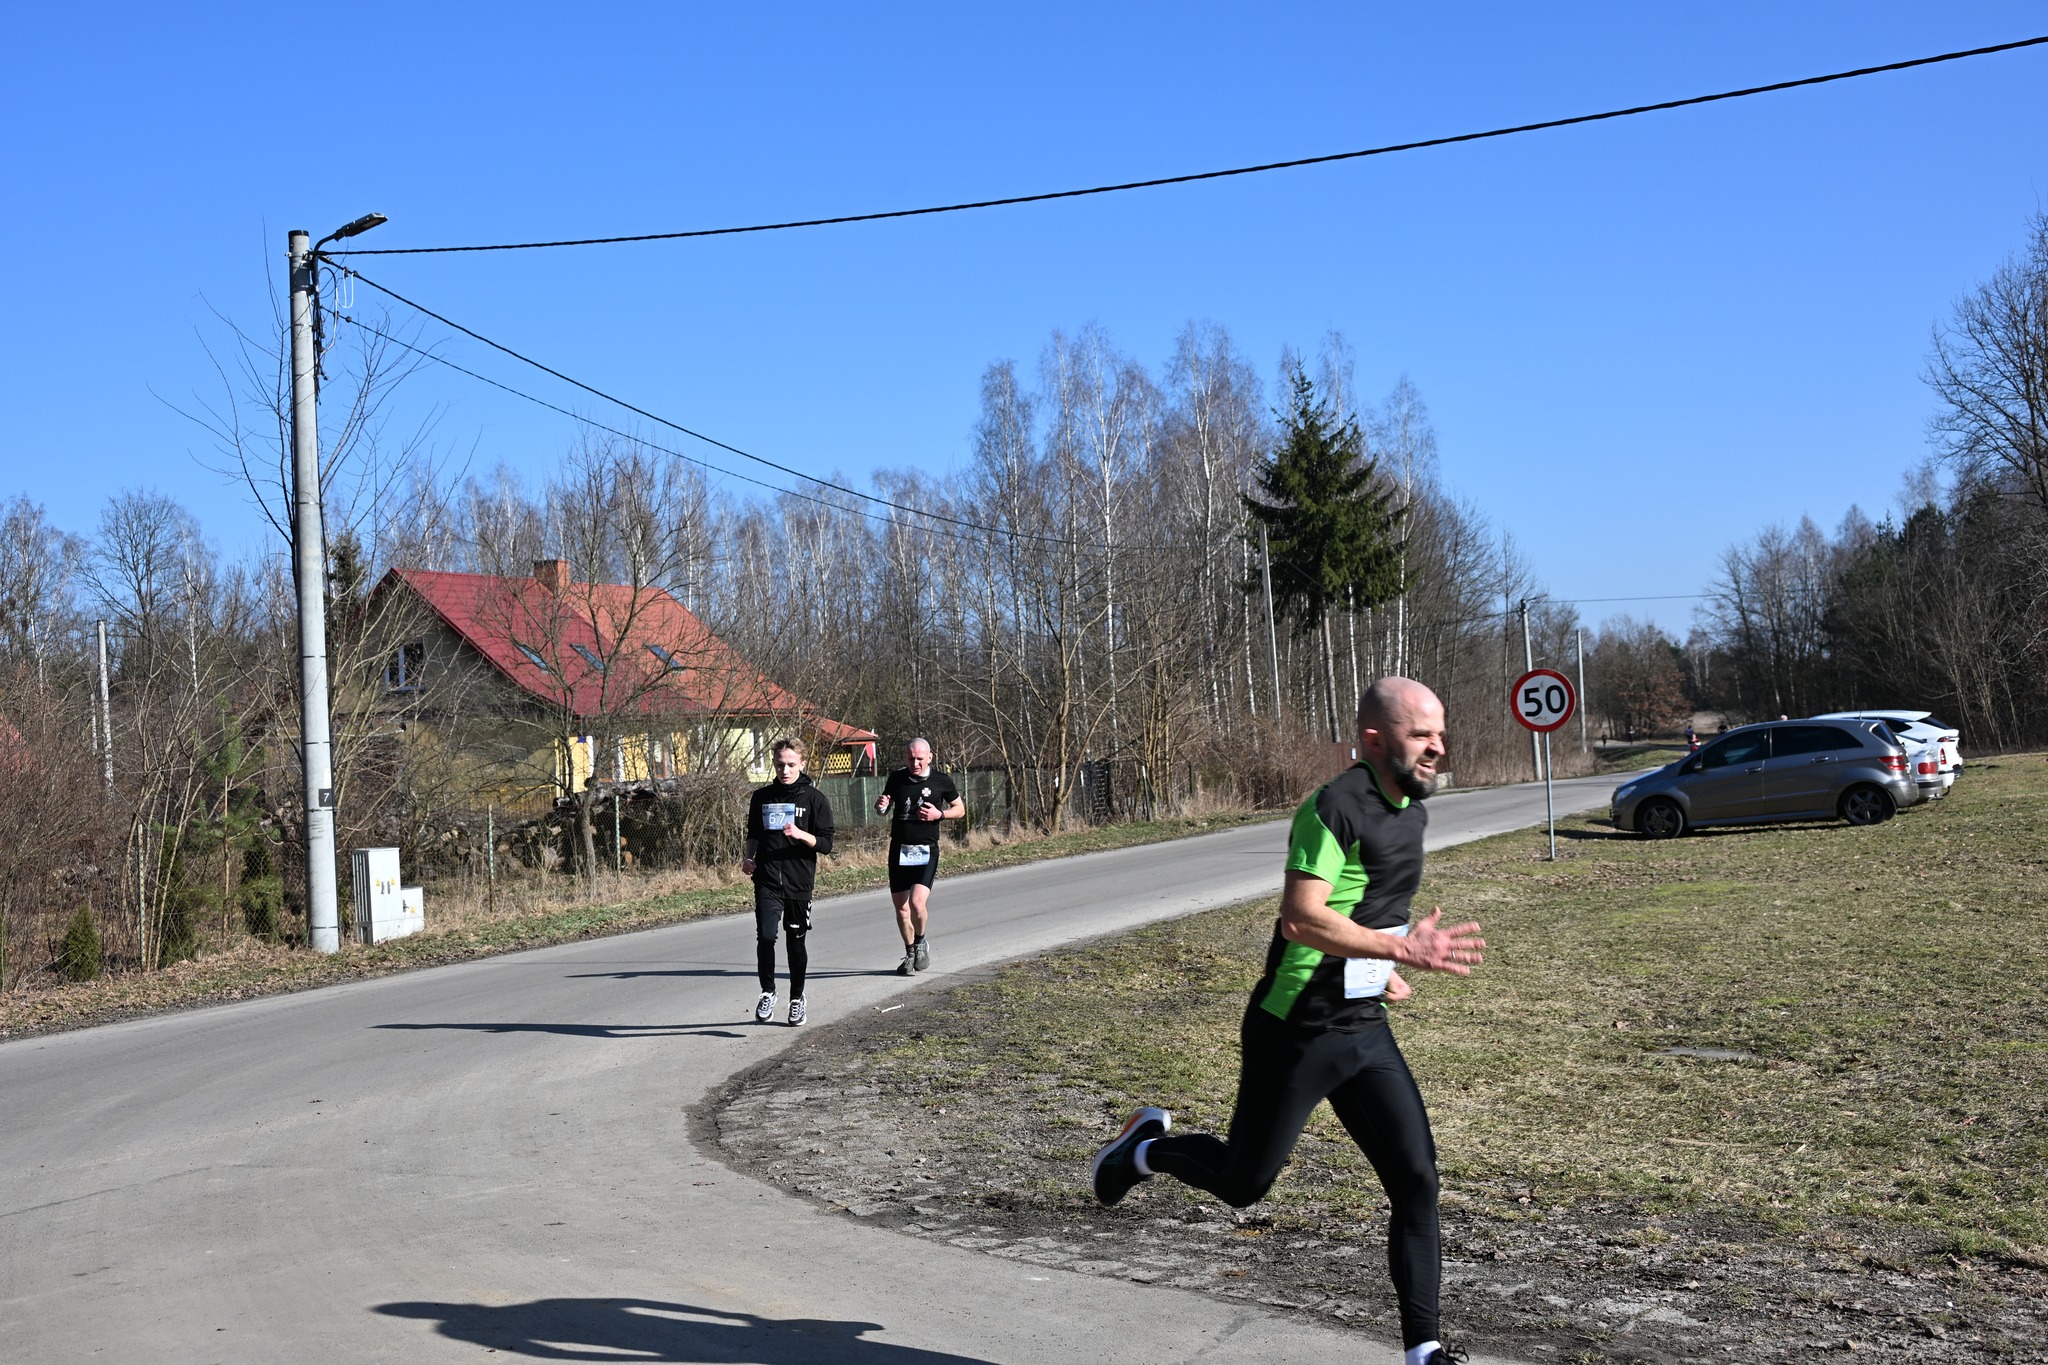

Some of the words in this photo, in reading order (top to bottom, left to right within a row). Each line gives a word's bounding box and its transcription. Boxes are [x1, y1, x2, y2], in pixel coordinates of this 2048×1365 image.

[1524, 684, 1566, 717] 50
[323, 792, 330, 802] 7
[768, 812, 786, 825] 67
[907, 851, 923, 862] 63
